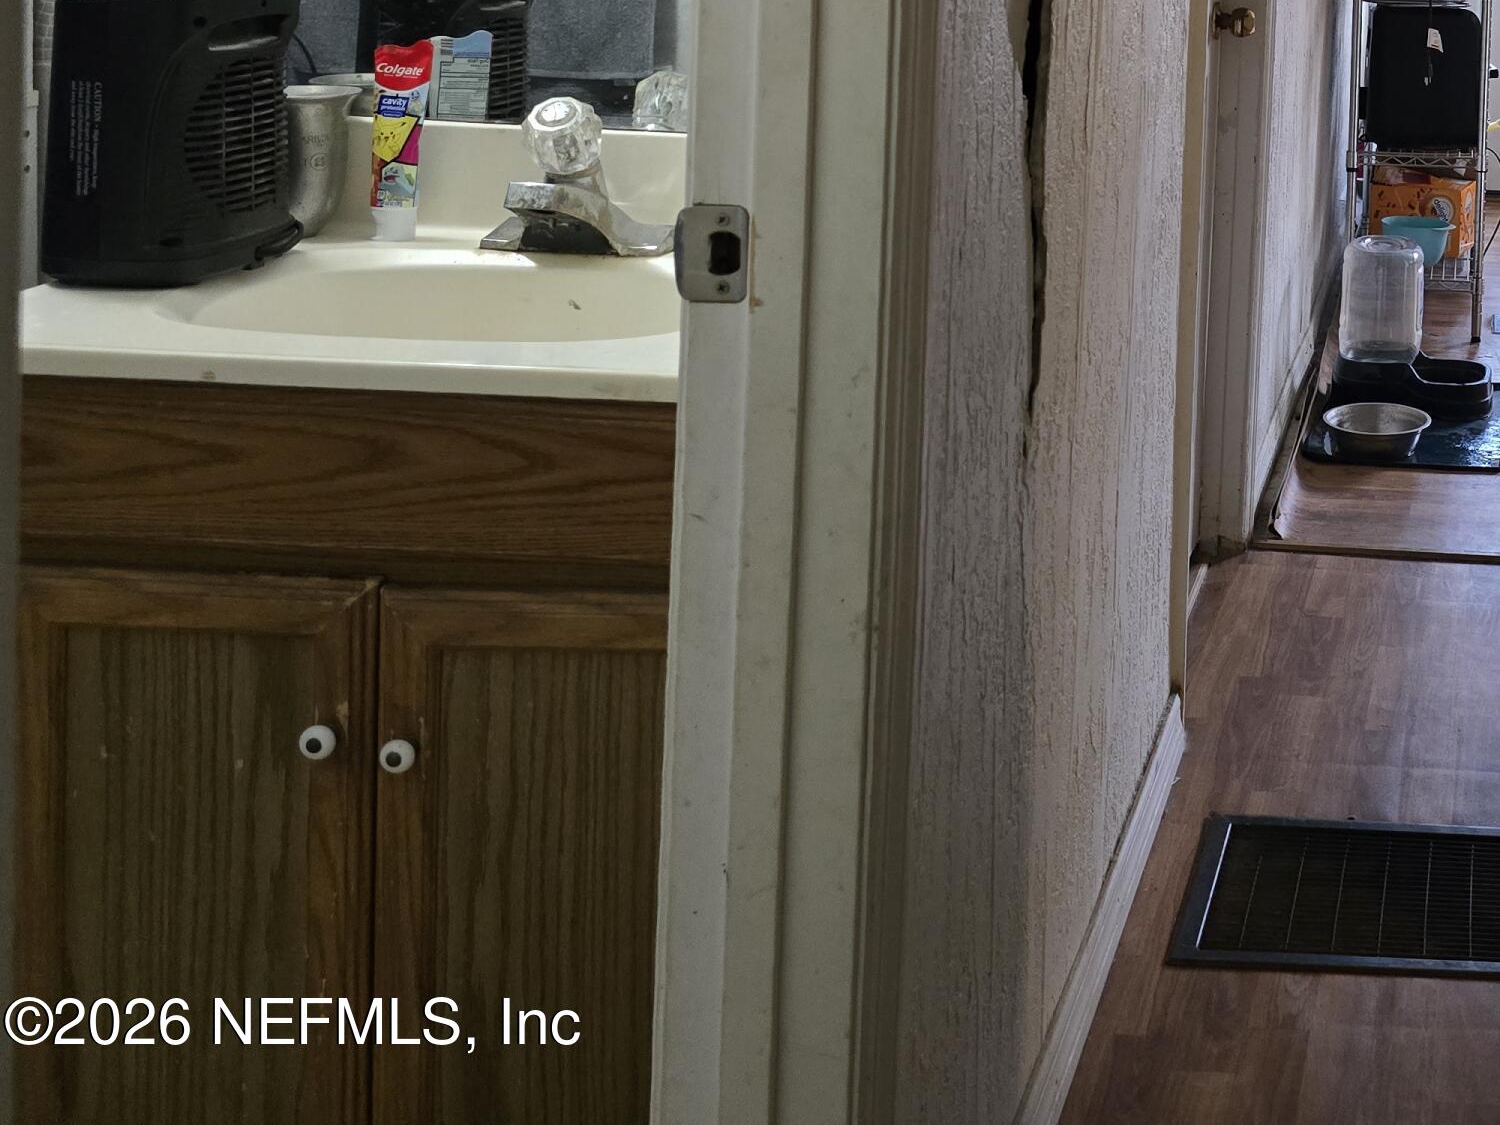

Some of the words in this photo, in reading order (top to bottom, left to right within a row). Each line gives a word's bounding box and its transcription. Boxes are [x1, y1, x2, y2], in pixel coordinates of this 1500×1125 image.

[376, 62, 424, 77] Colgate
[94, 81, 103, 122] CAUTION
[382, 98, 407, 107] cavity
